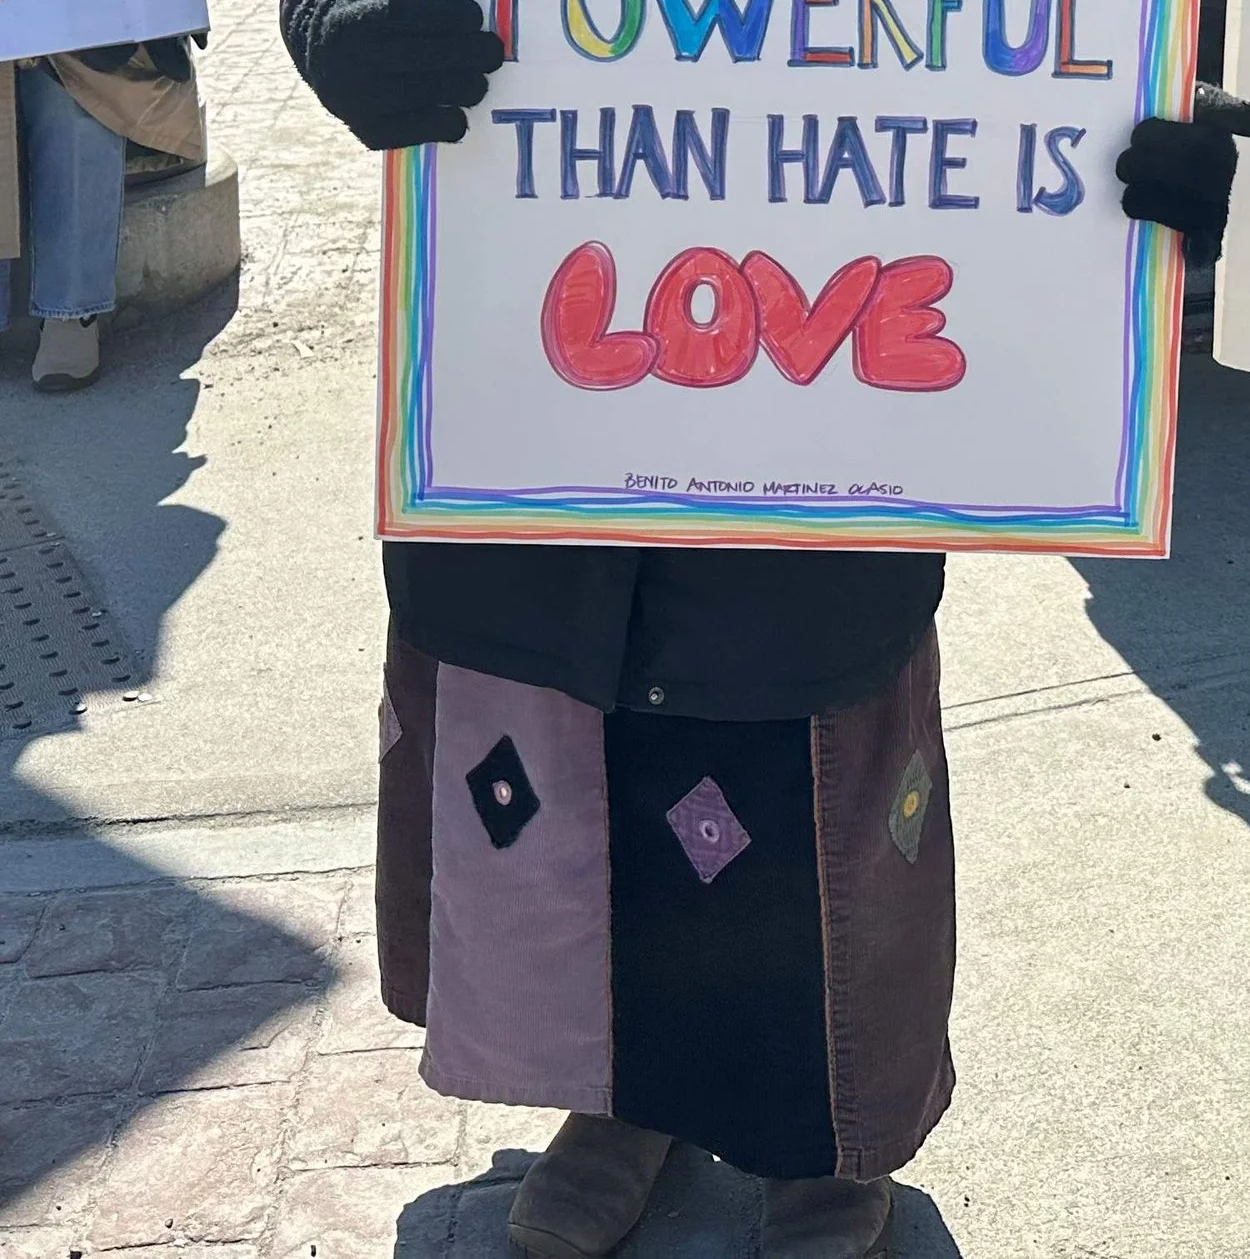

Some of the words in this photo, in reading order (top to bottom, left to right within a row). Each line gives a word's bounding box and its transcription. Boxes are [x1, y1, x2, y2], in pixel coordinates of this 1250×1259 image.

[492, 104, 730, 200] THAN
[767, 113, 980, 209] HATE
[1016, 122, 1087, 216] IS
[540, 240, 967, 391] LOVE
[624, 472, 678, 490] BENITO
[686, 478, 755, 493] ANTONIO
[763, 481, 838, 496] MARTINEZ
